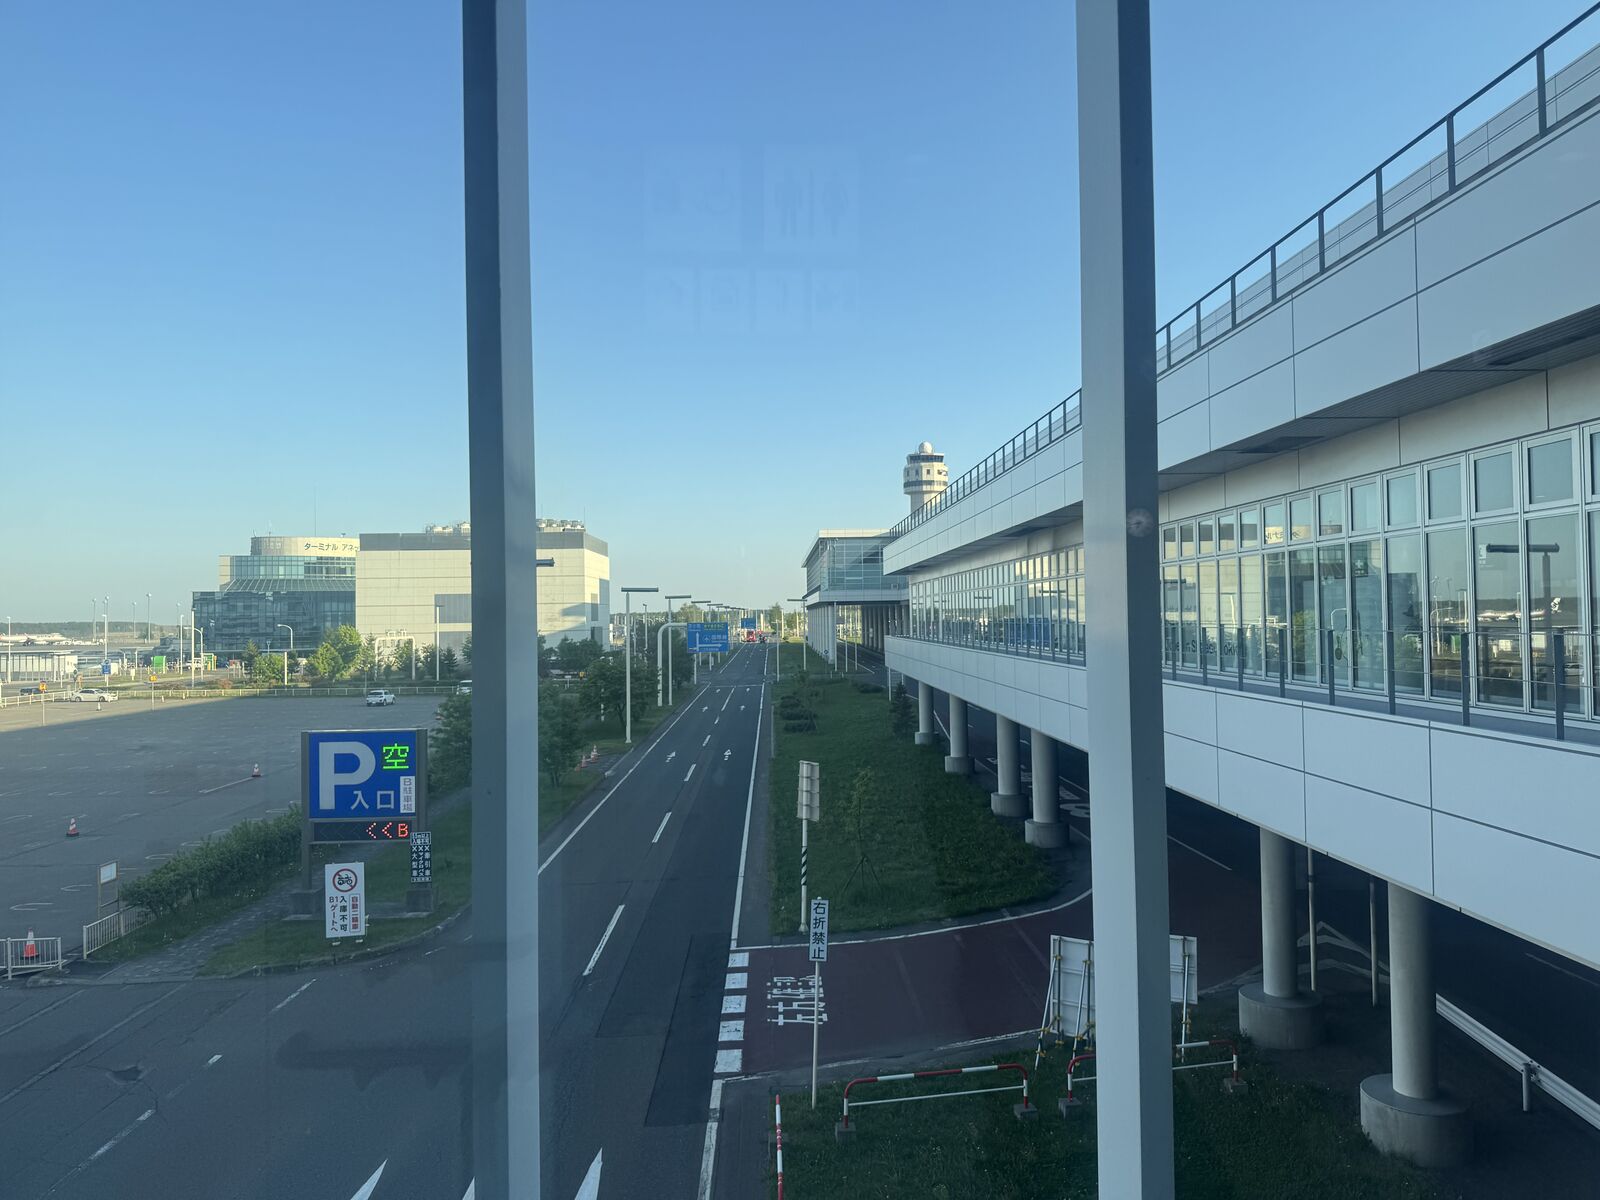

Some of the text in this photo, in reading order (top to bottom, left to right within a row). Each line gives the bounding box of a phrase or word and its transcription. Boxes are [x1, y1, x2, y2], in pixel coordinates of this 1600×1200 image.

[304, 542, 338, 551] ターミナル
[382, 743, 409, 770] 空
[319, 741, 376, 810] P
[350, 790, 395, 810] 入口
[811, 902, 826, 960] 右折禁止
